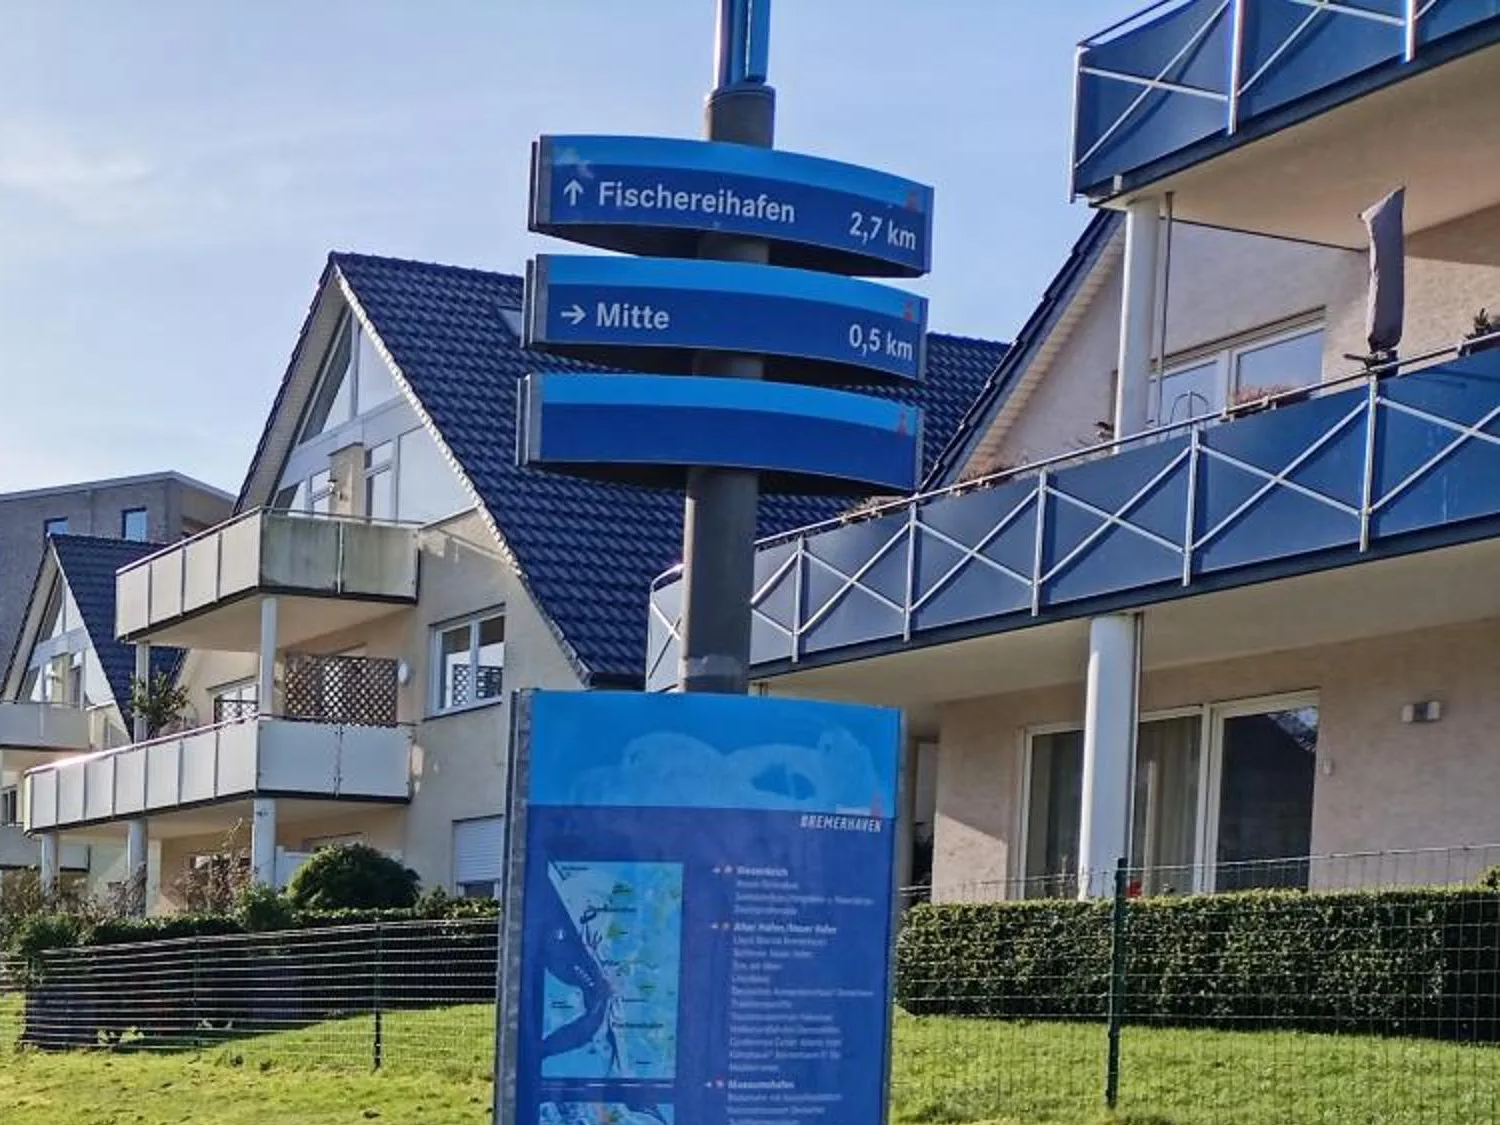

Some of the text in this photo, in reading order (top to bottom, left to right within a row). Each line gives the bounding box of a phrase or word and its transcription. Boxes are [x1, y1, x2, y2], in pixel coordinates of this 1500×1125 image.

[599, 181, 917, 251] Fischereihafen 2,7 km
[596, 302, 913, 361] Mitte 0,5 km
[800, 814, 882, 832] BREMERHAVEN
